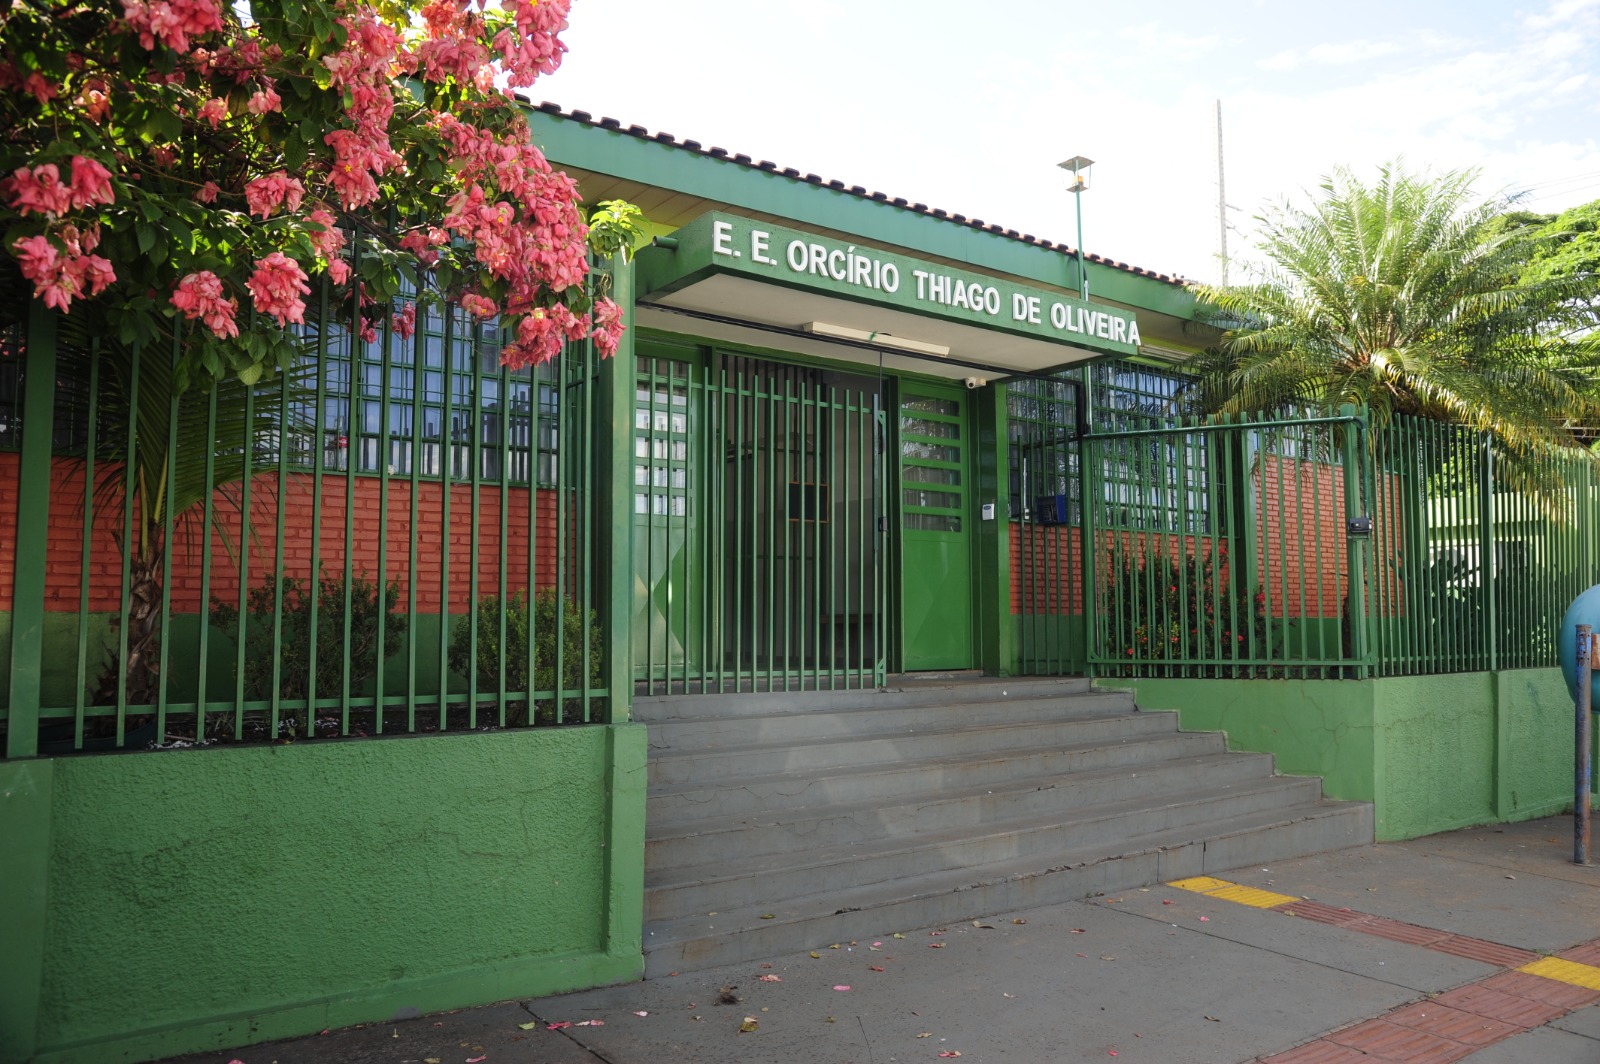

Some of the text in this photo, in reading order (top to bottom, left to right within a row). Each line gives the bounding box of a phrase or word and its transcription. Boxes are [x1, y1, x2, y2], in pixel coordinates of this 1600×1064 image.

[713, 220, 1141, 346] E. E. ORCÍRIO THIAGO DE OLIVEIRA
